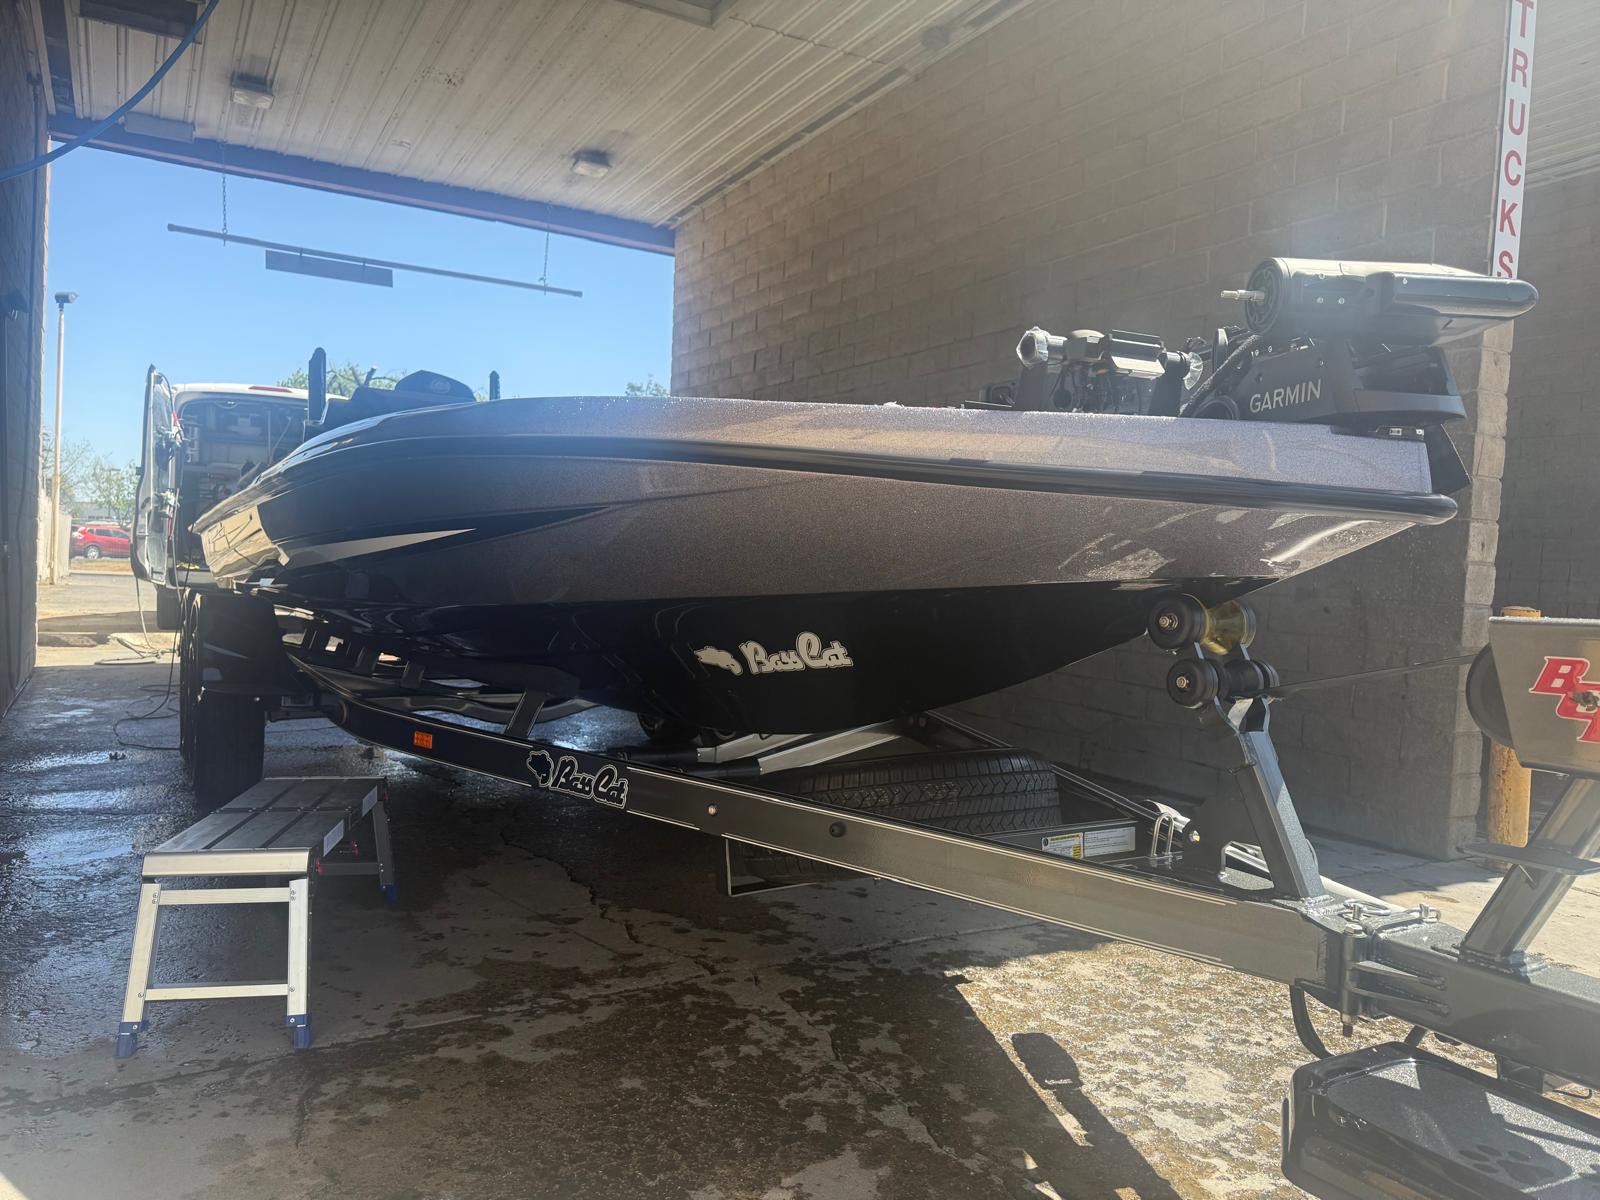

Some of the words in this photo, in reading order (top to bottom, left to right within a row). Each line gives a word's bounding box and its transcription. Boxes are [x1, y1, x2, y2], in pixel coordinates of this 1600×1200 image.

[1497, 0, 1534, 278] TRUCKS
[1249, 379, 1321, 413] GARMIN
[738, 639, 806, 675] Bass
[795, 631, 853, 669] Cat
[549, 756, 595, 799] Bass
[593, 764, 628, 809] Cat
